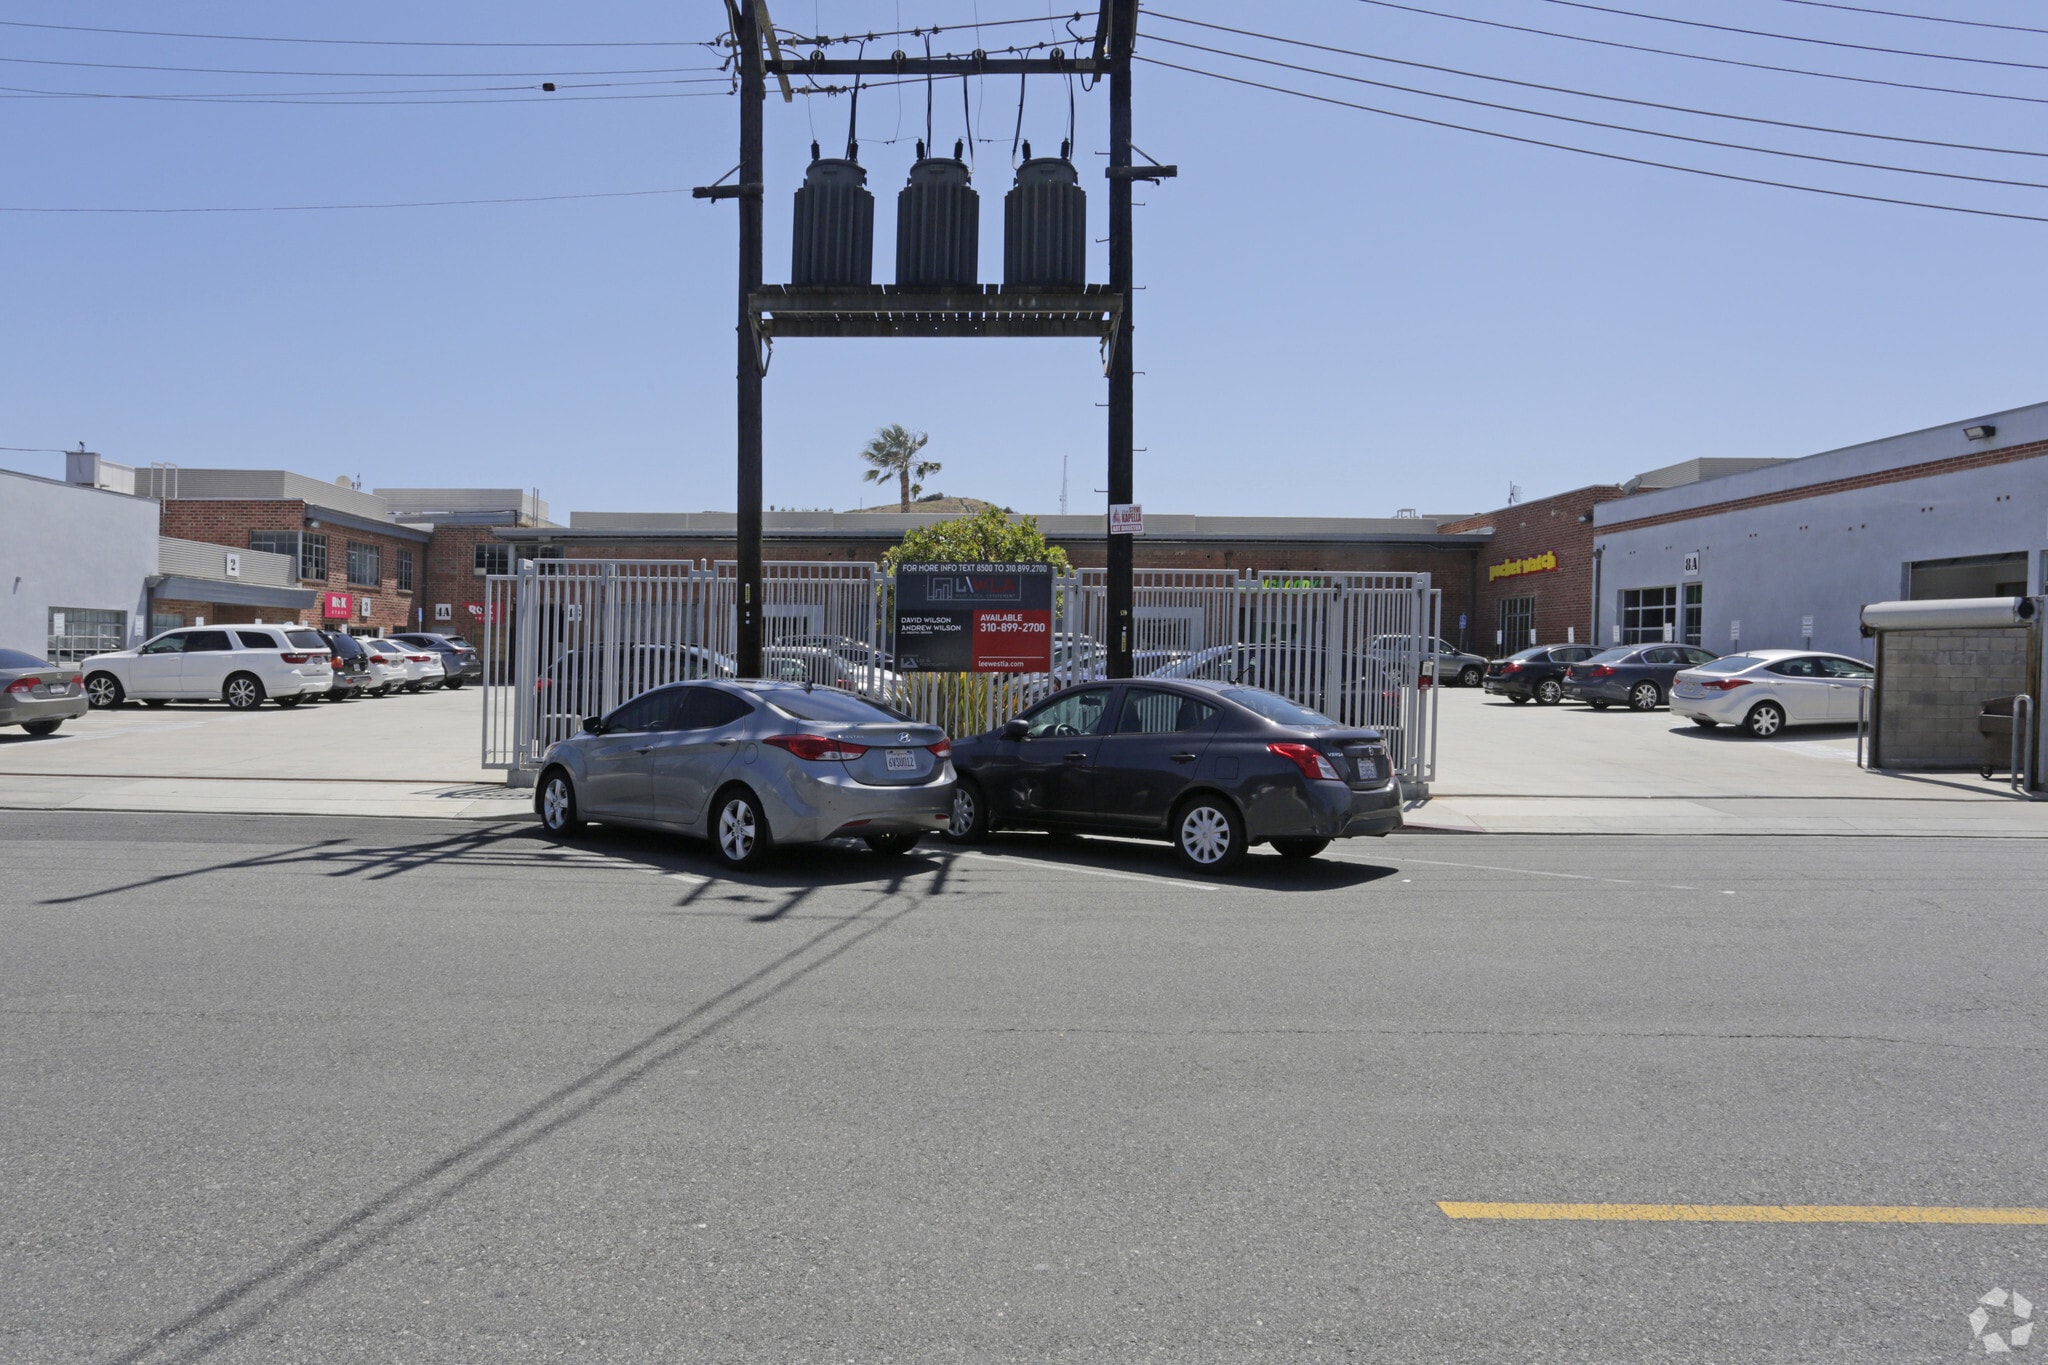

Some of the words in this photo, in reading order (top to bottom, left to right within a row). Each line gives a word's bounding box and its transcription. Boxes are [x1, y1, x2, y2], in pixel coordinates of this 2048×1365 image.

[230, 558, 236, 571] 2
[902, 564, 918, 572] FOR
[919, 564, 939, 572] MORE
[940, 564, 957, 572] INFO
[959, 564, 976, 572] TEXT
[976, 564, 993, 572] 8500
[995, 564, 1004, 572] TO
[1005, 564, 1048, 573] 310.899.2700
[1685, 557, 1698, 571] 8A
[364, 601, 369, 613] 3
[436, 607, 450, 617] 4A
[980, 613, 1023, 621] AVAILABLE
[980, 622, 1046, 633] 310-899-2700
[978, 660, 1025, 668] leewestla.com
